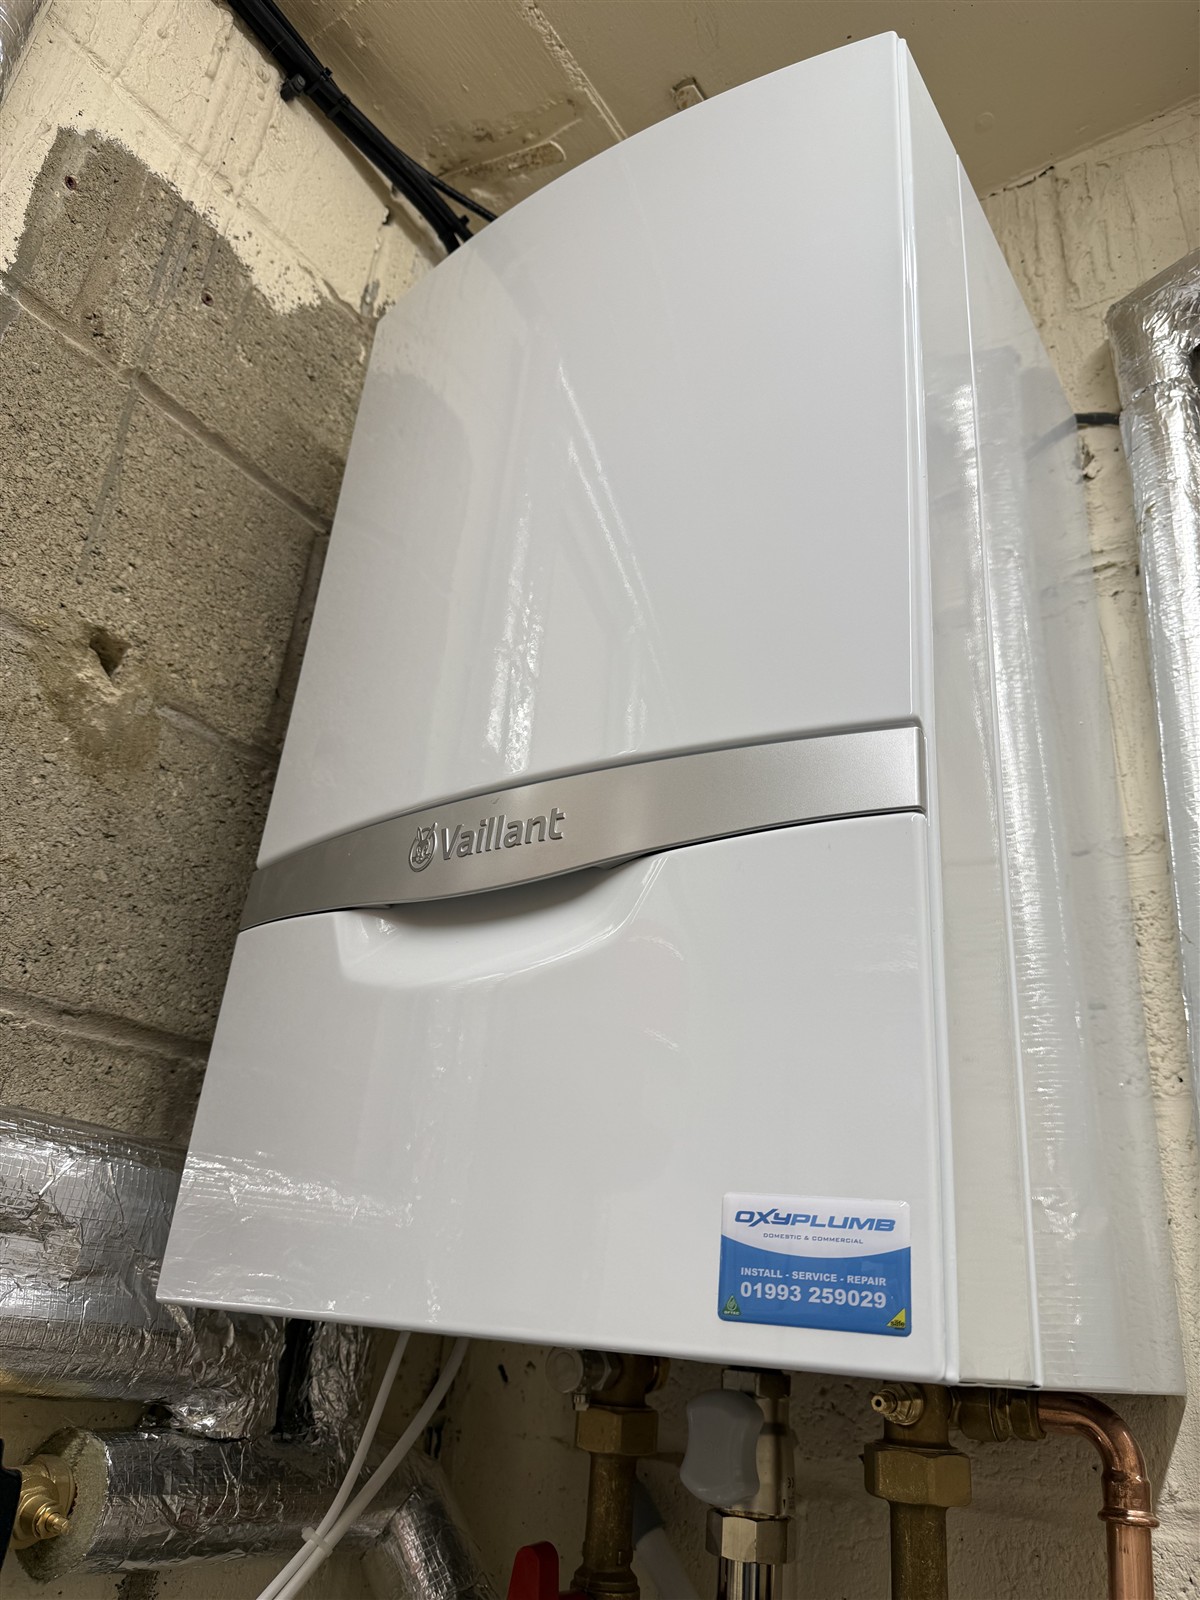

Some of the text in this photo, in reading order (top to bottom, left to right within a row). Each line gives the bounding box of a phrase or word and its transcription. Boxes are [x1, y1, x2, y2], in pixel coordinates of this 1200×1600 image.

[441, 808, 566, 860] Vaillant
[763, 1232, 802, 1241] DOMESTIC
[812, 1235, 864, 1244] COMMERCIAL
[740, 1267, 783, 1278] INSTALL
[791, 1271, 838, 1282] SERVICE
[847, 1275, 887, 1286] REPAIR
[740, 1281, 887, 1308] 01993 259029
